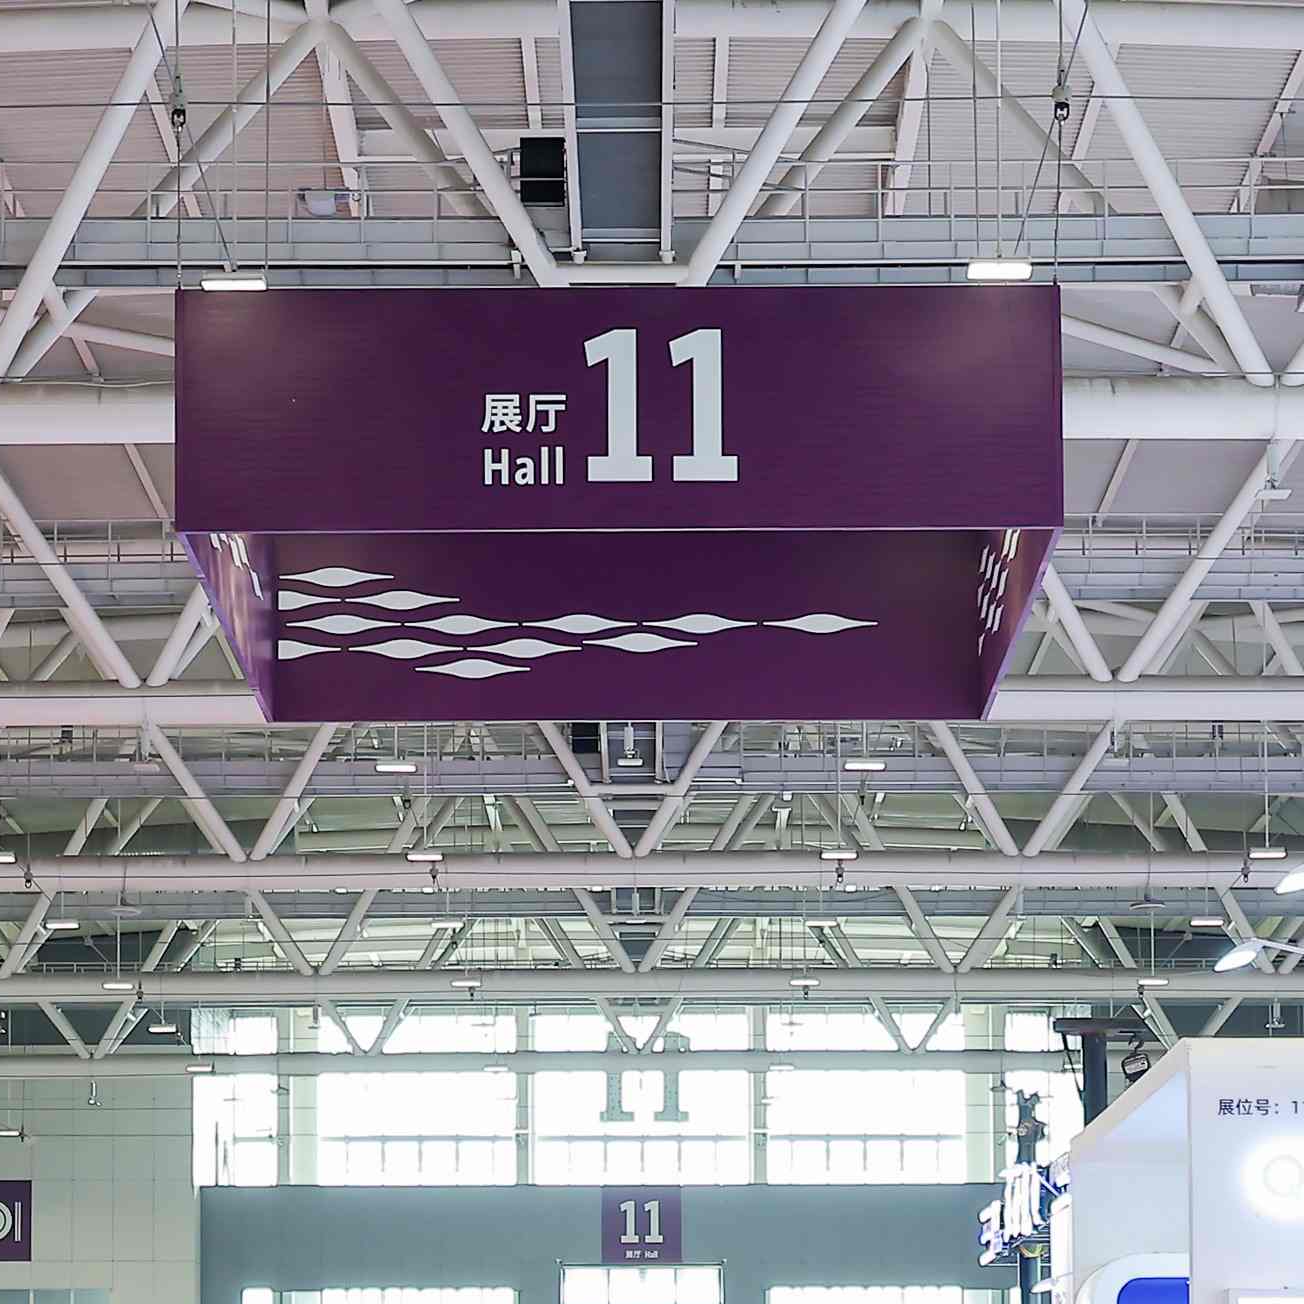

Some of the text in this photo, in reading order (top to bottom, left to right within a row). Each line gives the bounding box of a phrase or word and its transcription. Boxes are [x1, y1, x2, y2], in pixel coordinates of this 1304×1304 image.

[480, 392, 567, 434] 展厅
[483, 326, 740, 487] Hall 11
[619, 1200, 664, 1244] 11
